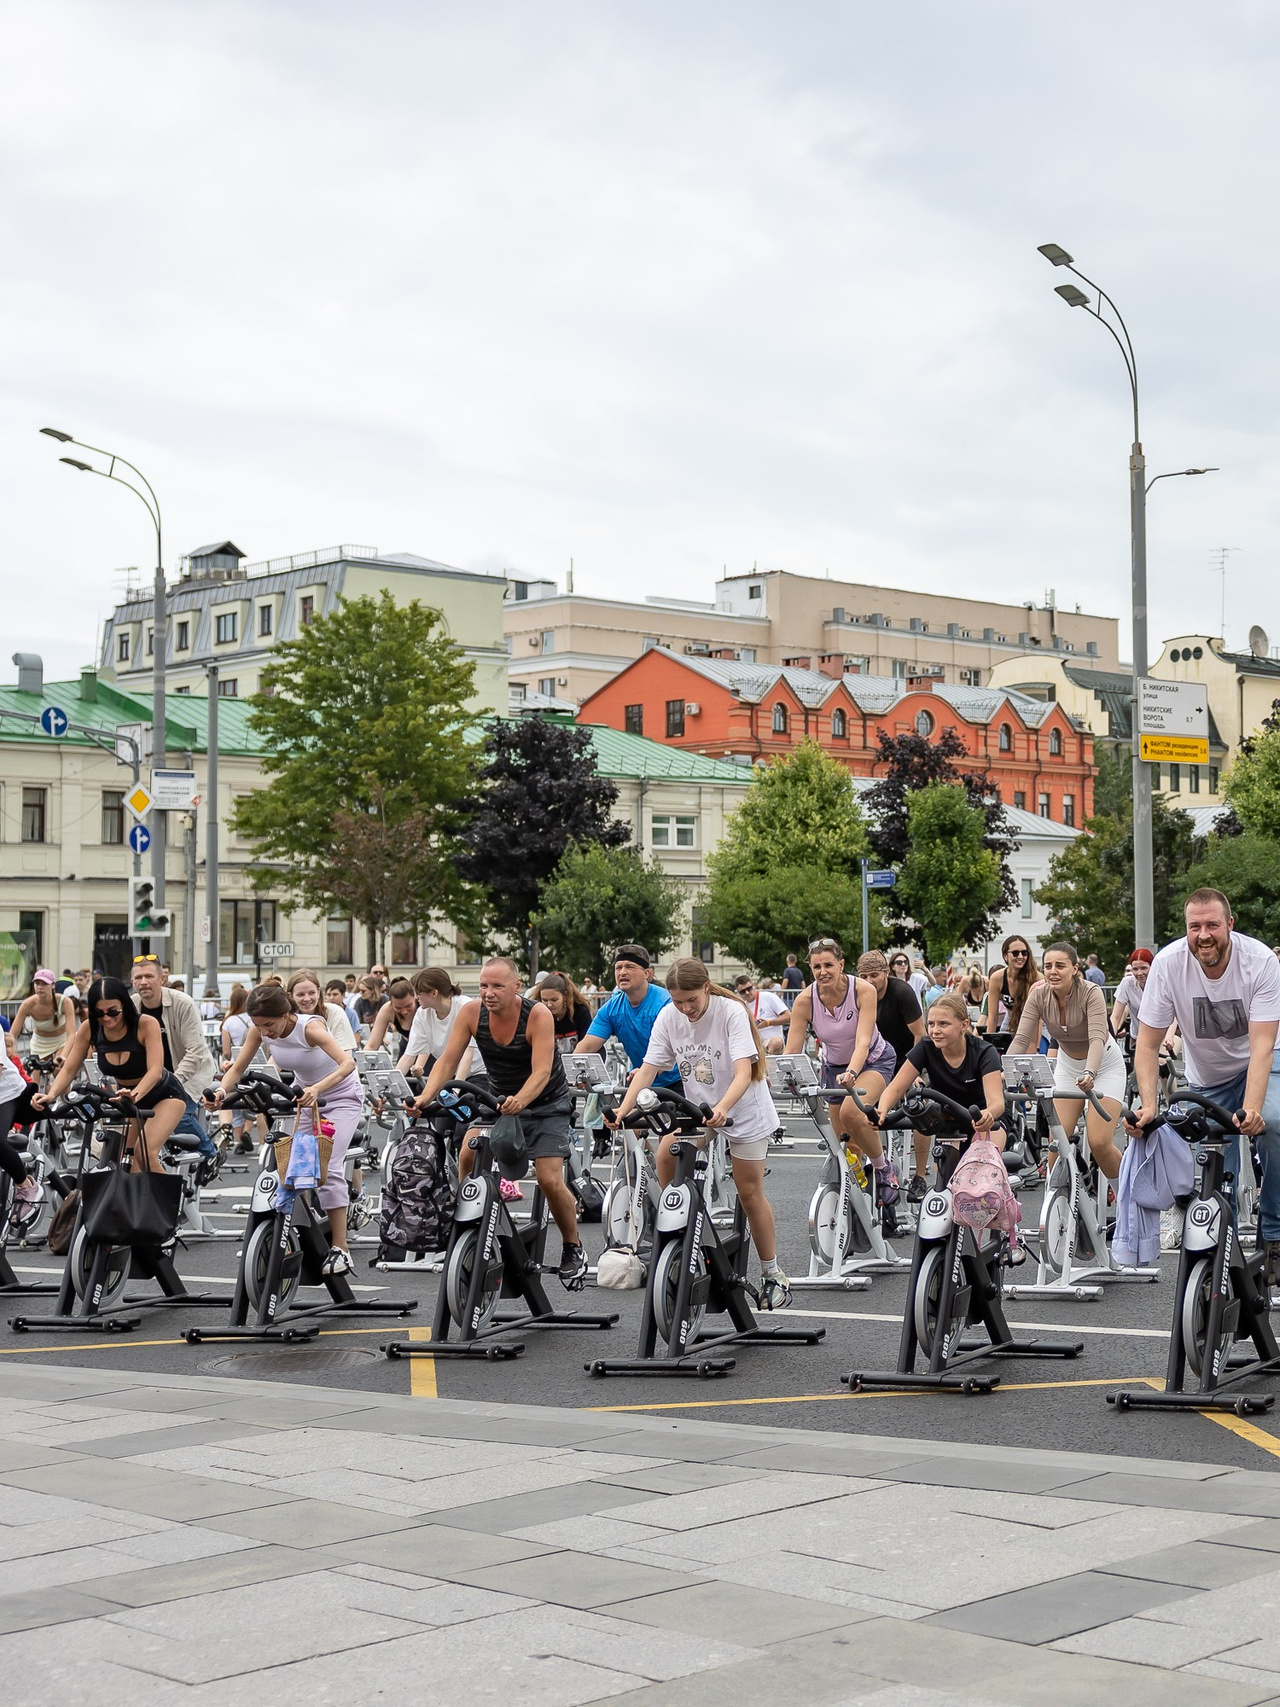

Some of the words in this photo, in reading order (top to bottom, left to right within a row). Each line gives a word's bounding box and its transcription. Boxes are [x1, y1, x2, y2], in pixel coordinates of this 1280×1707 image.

[1149, 684, 1179, 692] НИКИТСКАЯ
[1143, 706, 1173, 714] НИКИТСКИЕ
[1143, 714, 1164, 722] ВОРОТА
[264, 944, 292, 955] СТОП
[262, 1179, 273, 1189] GT
[464, 1186, 476, 1196] GT
[666, 1194, 680, 1205] GT
[929, 1200, 942, 1212] GT
[1195, 1209, 1208, 1221] GT
[483, 1201, 498, 1260] GYMTOUCH
[689, 1212, 703, 1274] GYMTOUCH
[952, 1225, 964, 1283] GYMTOUC
[1220, 1225, 1232, 1295] GYMTOUCH
[92, 1284, 102, 1305] 009
[268, 1294, 277, 1316] 009
[471, 1306, 480, 1329] 009
[679, 1320, 688, 1345] 009
[942, 1334, 950, 1360] 009
[1212, 1350, 1220, 1376] 009
